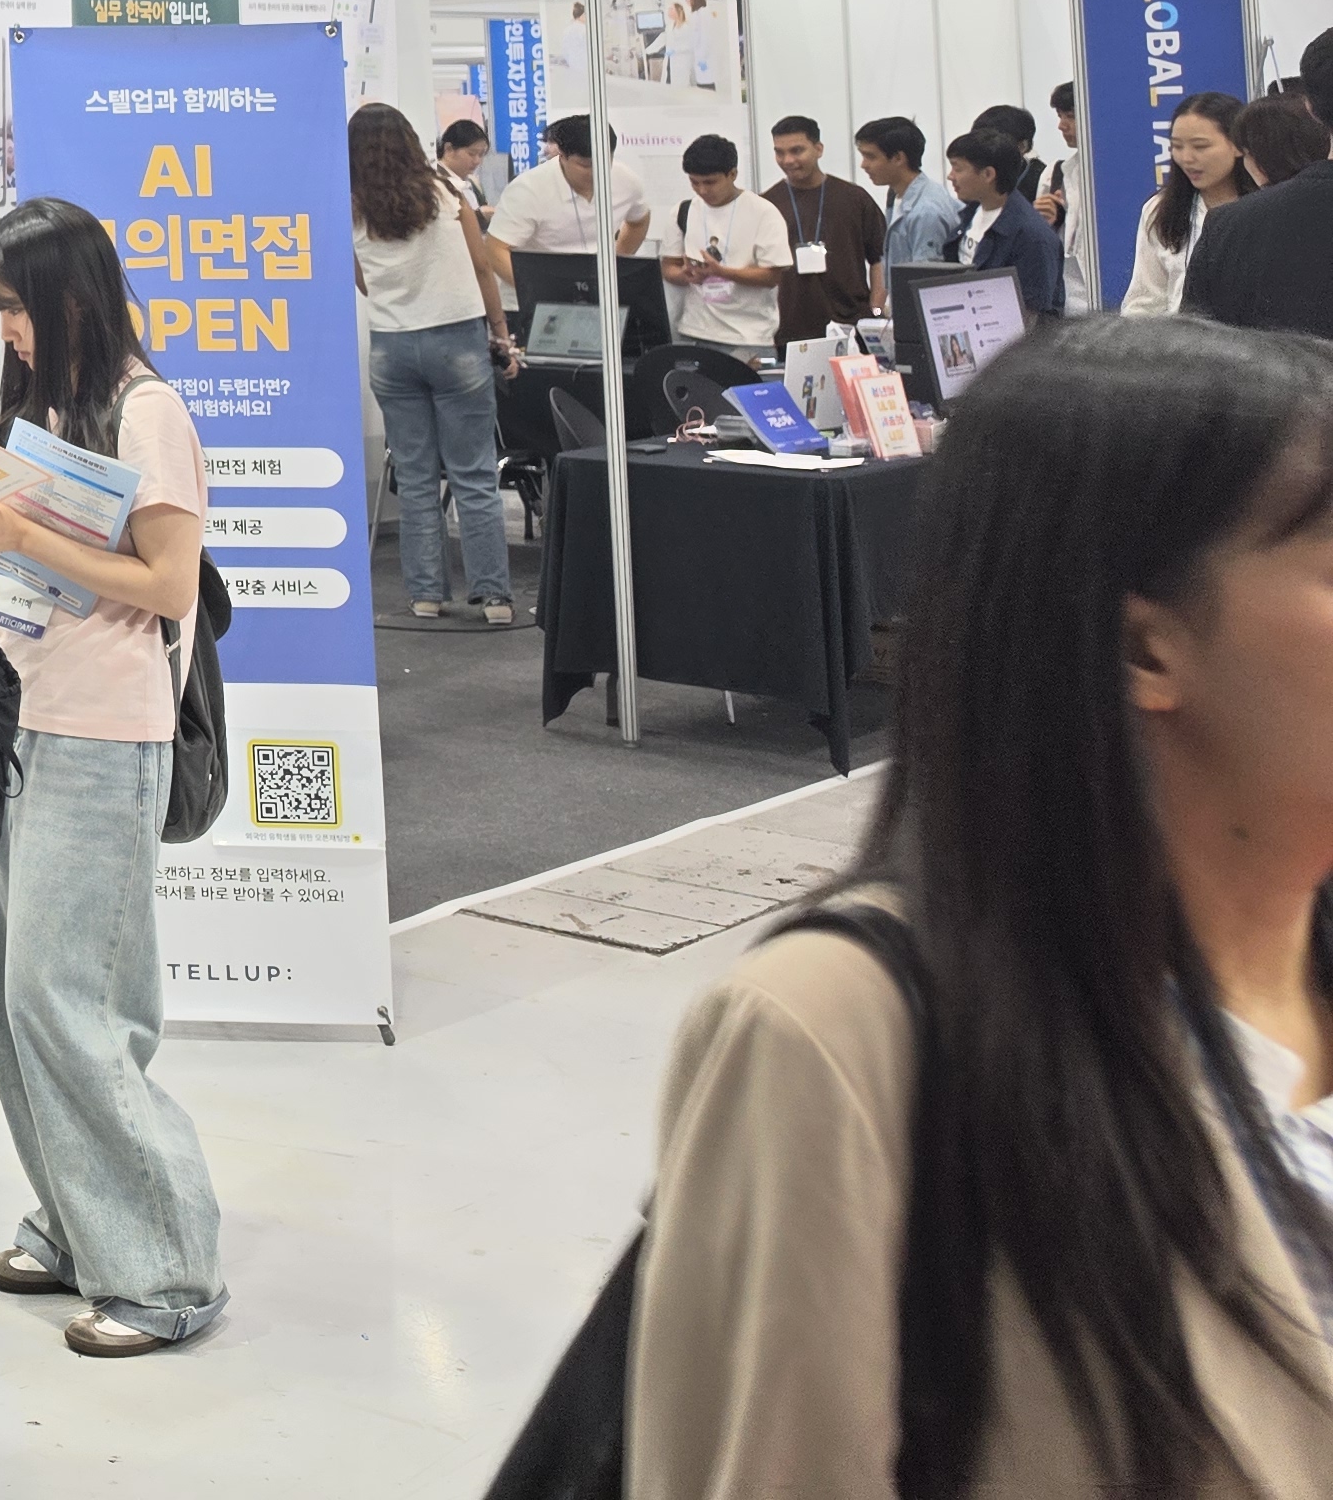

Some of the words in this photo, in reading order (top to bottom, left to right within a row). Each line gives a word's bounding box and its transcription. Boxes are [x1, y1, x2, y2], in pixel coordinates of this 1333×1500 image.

[90, 0, 122, 24] '실무
[126, 0, 211, 25] 한국어'입니다.
[84, 89, 177, 116] 스텔업과
[182, 88, 277, 114] 함께하는
[621, 132, 683, 146] business
[139, 145, 212, 198] AI
[101, 213, 312, 281] 의면접
[168, 378, 214, 396] 면접이
[218, 378, 291, 395] 두렵다면?
[189, 400, 272, 417] 체험하세요!
[204, 459, 247, 476] 의면접
[251, 459, 282, 476] 체험
[232, 519, 263, 536] 제공
[236, 580, 267, 596] 맞춤
[271, 579, 319, 596] 서비스
[210, 866, 252, 882] 정보를
[256, 868, 331, 883] 입력하세요.
[155, 885, 196, 901] 력서를
[201, 886, 228, 901] 바로
[233, 887, 275, 902] 받아볼
[280, 889, 294, 901] 수
[298, 888, 344, 903] 있어요!
[167, 963, 293, 982] TELLUP:
